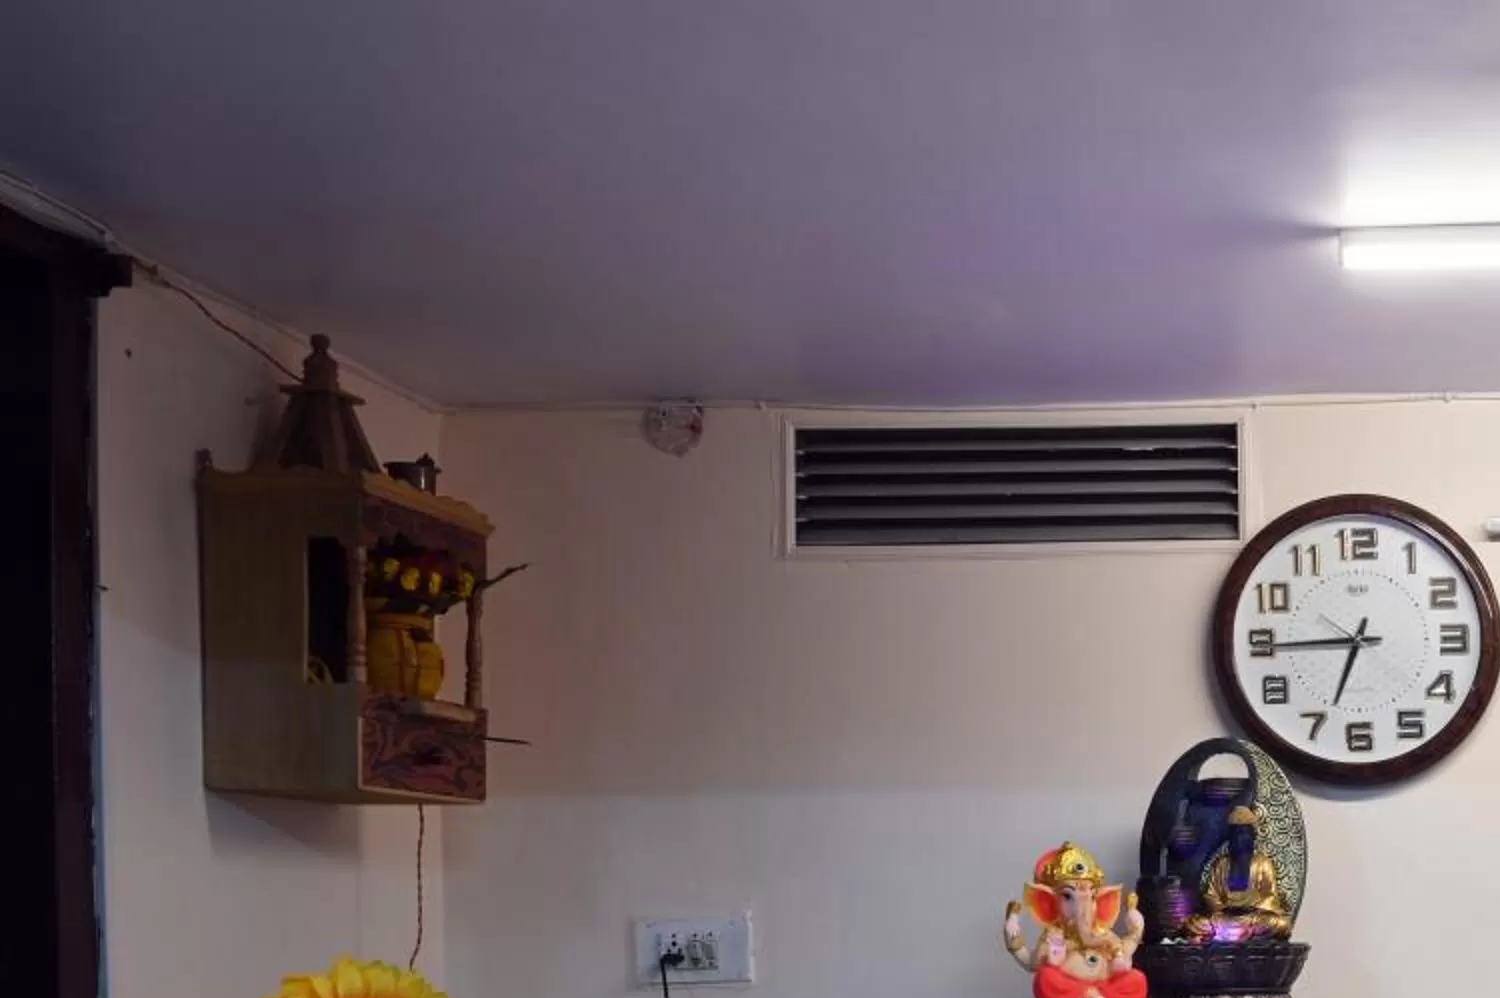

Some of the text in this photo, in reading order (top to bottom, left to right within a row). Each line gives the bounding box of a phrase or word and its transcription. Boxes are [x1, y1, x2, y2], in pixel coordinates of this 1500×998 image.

[1334, 528, 1378, 560] 12
[1402, 541, 1416, 575] 1
[1288, 544, 1321, 576] 11
[1255, 583, 1290, 613] 10
[1429, 578, 1456, 609] 2
[1249, 629, 1274, 657] 9
[1439, 624, 1470, 656] 3
[1262, 675, 1289, 704] 8
[1425, 670, 1456, 704] 4
[1300, 712, 1327, 741] 7
[1346, 722, 1373, 751] 6
[1397, 710, 1424, 739] 5
